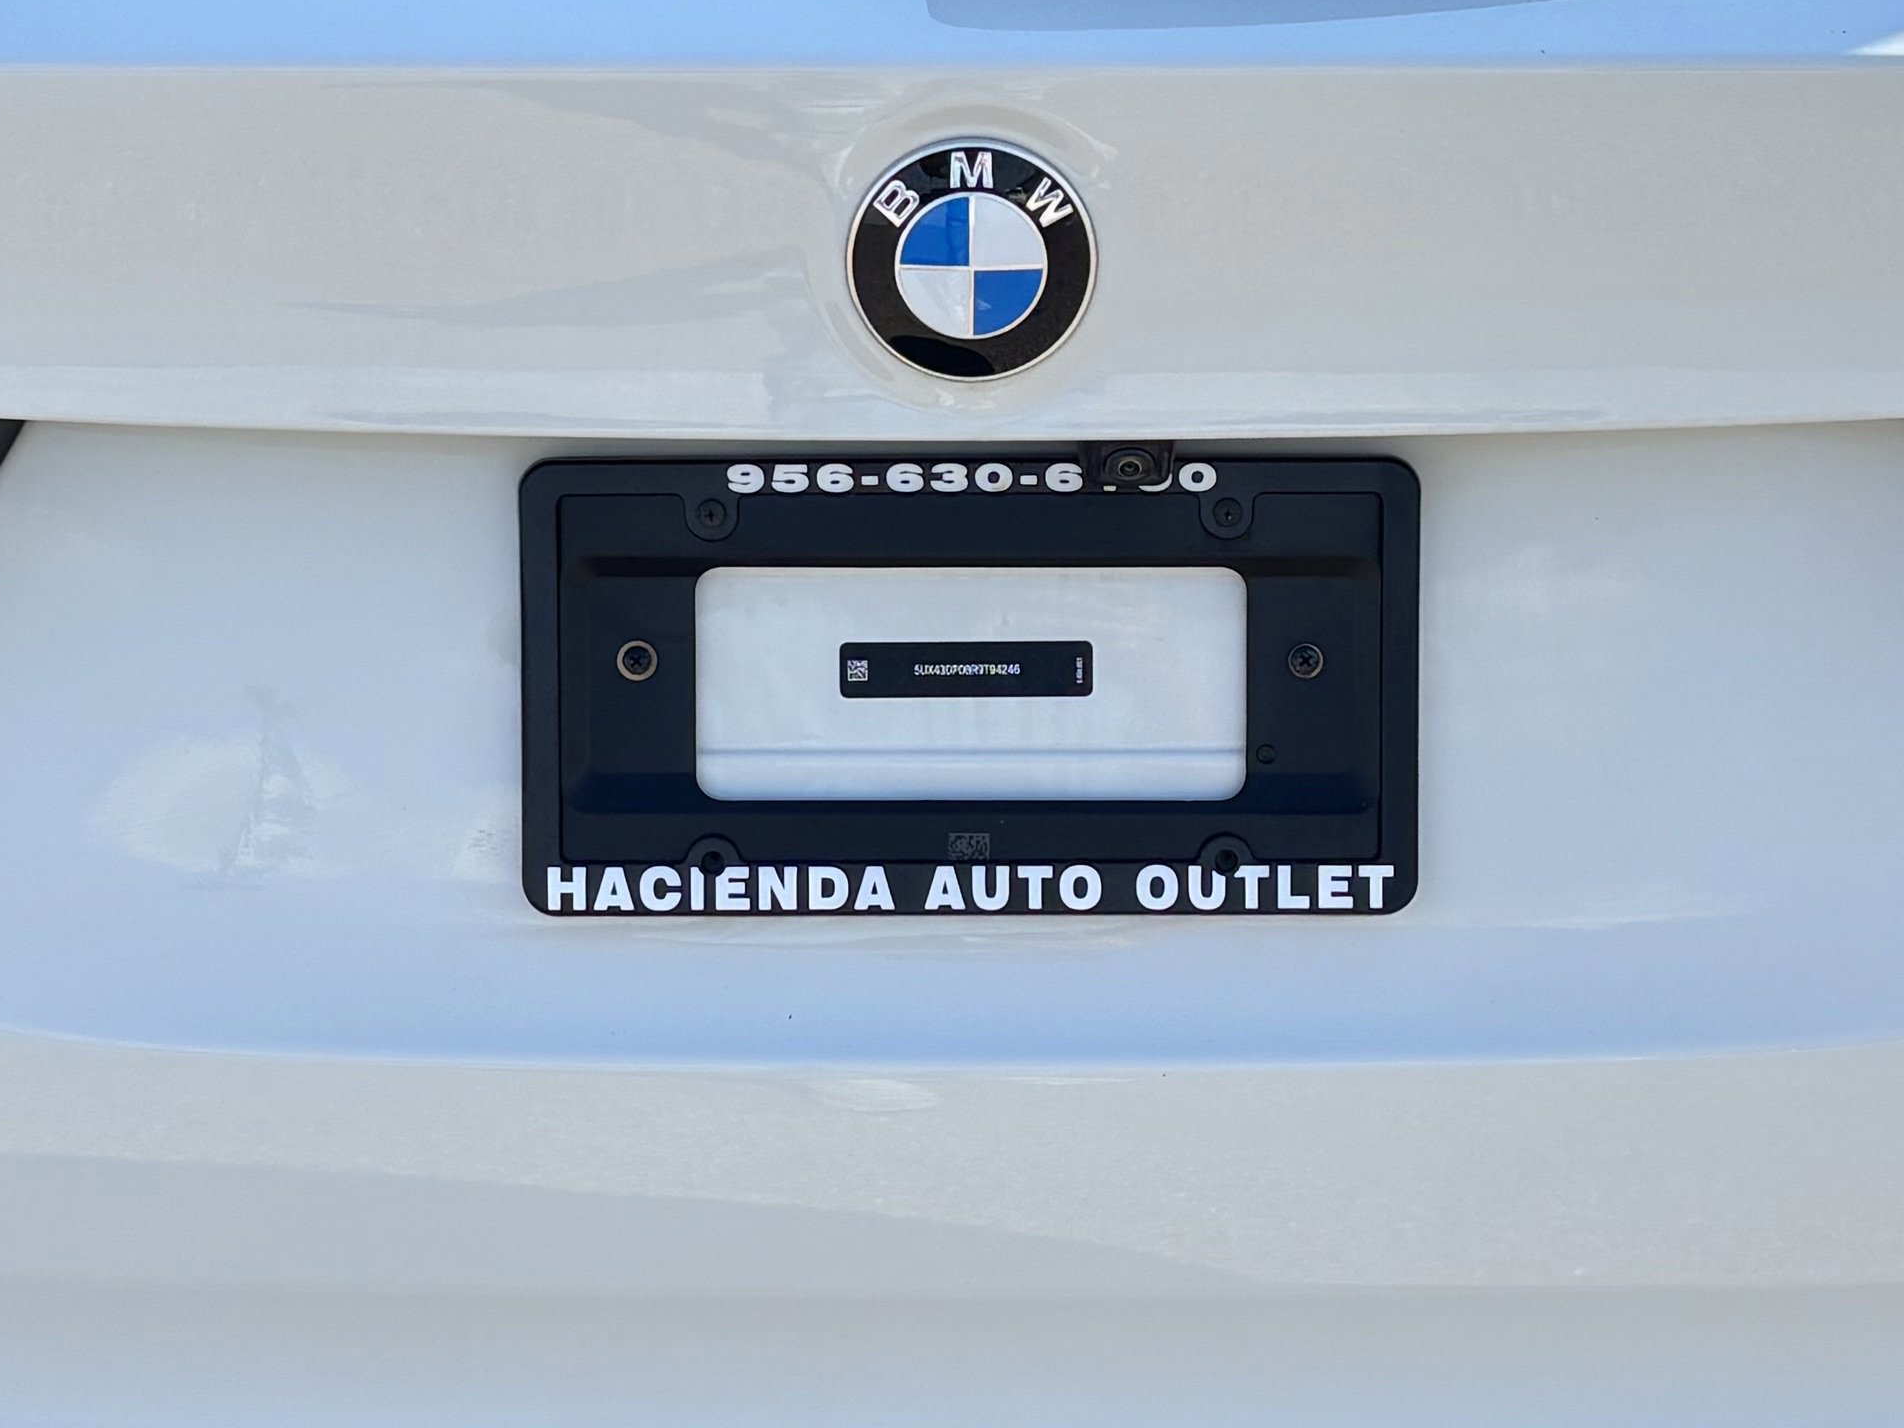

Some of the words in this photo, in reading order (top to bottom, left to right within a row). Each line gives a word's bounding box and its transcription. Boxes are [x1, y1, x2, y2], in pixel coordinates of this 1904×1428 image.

[872, 150, 1074, 229] BMW
[726, 462, 1217, 494] 956-630-60
[545, 864, 896, 913] HACIENDA
[923, 864, 1105, 913] AUTO
[1132, 864, 1397, 913] OUTLET
